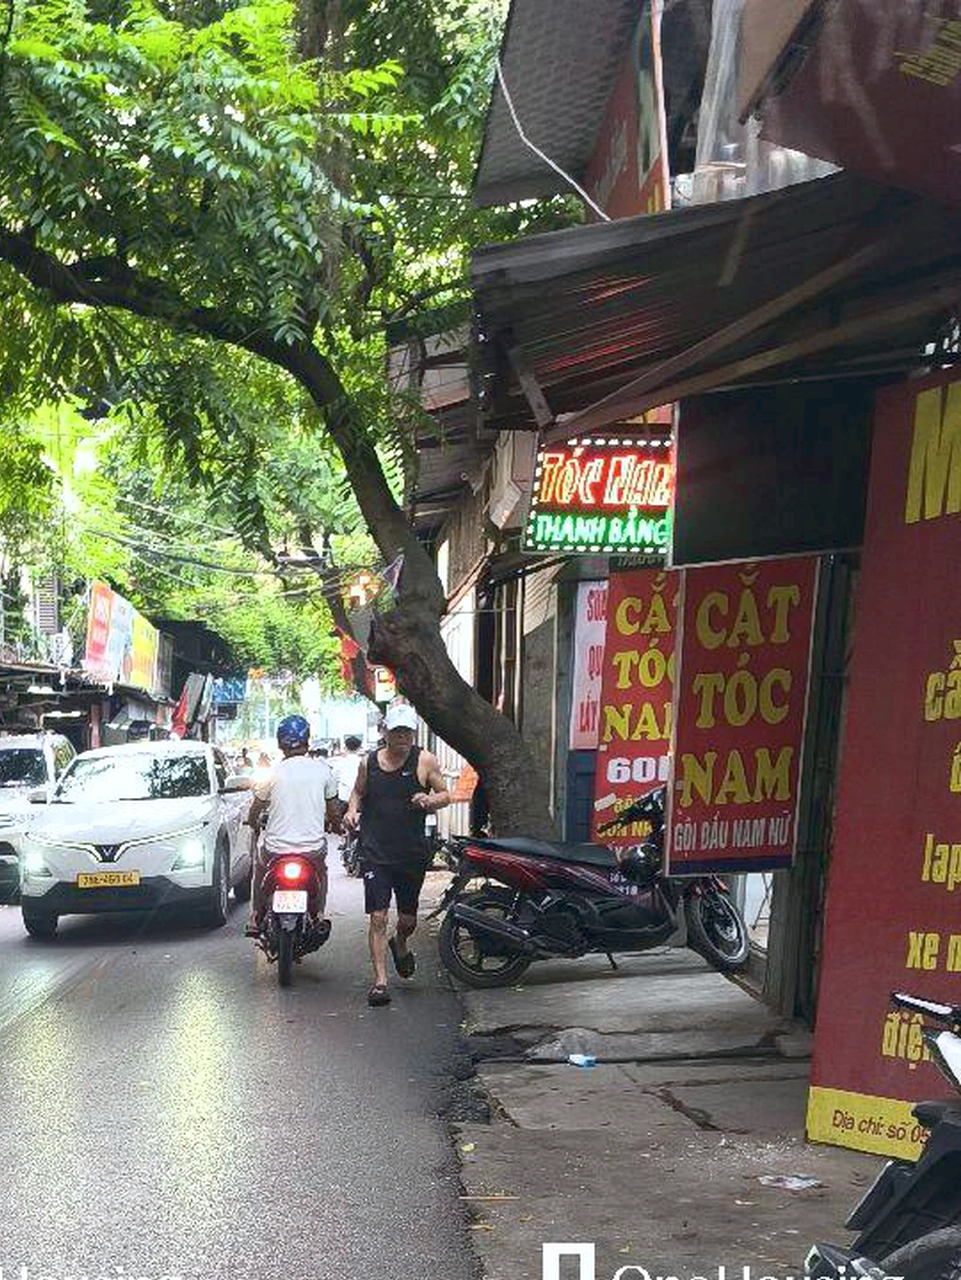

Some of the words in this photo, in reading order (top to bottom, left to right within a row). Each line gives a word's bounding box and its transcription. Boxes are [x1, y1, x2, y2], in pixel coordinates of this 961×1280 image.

[536, 515, 606, 542] THANH
[616, 573, 677, 636] CẮ
[696, 564, 800, 650] CẮT
[692, 652, 792, 728] TÓC
[681, 746, 794, 807] NAM
[732, 818, 765, 849] NAM
[768, 809, 792, 847] NỮ
[906, 931, 939, 971] xe
[832, 1109, 855, 1134] Địa
